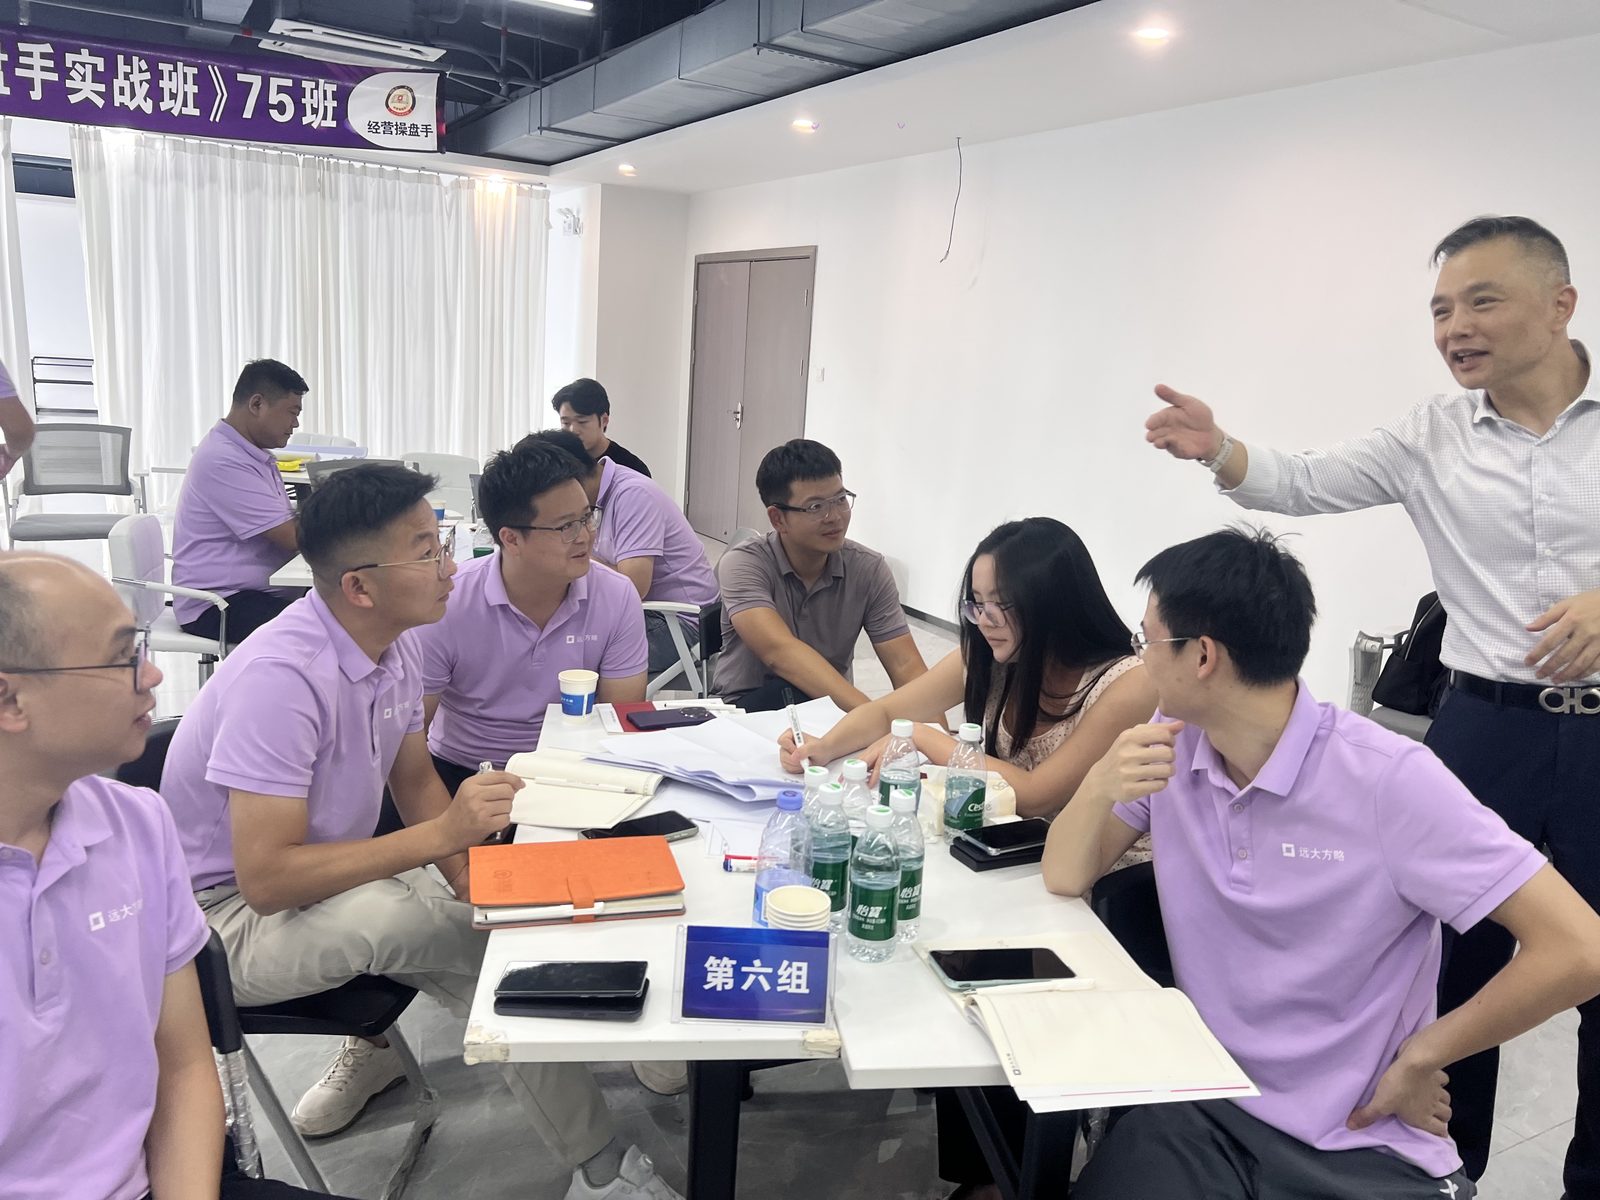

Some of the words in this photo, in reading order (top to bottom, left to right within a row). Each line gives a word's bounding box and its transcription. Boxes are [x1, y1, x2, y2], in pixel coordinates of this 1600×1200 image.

[367, 120, 433, 138] 经营操盘手
[1299, 847, 1345, 861] 远大方略
[702, 955, 810, 994] 第六组
